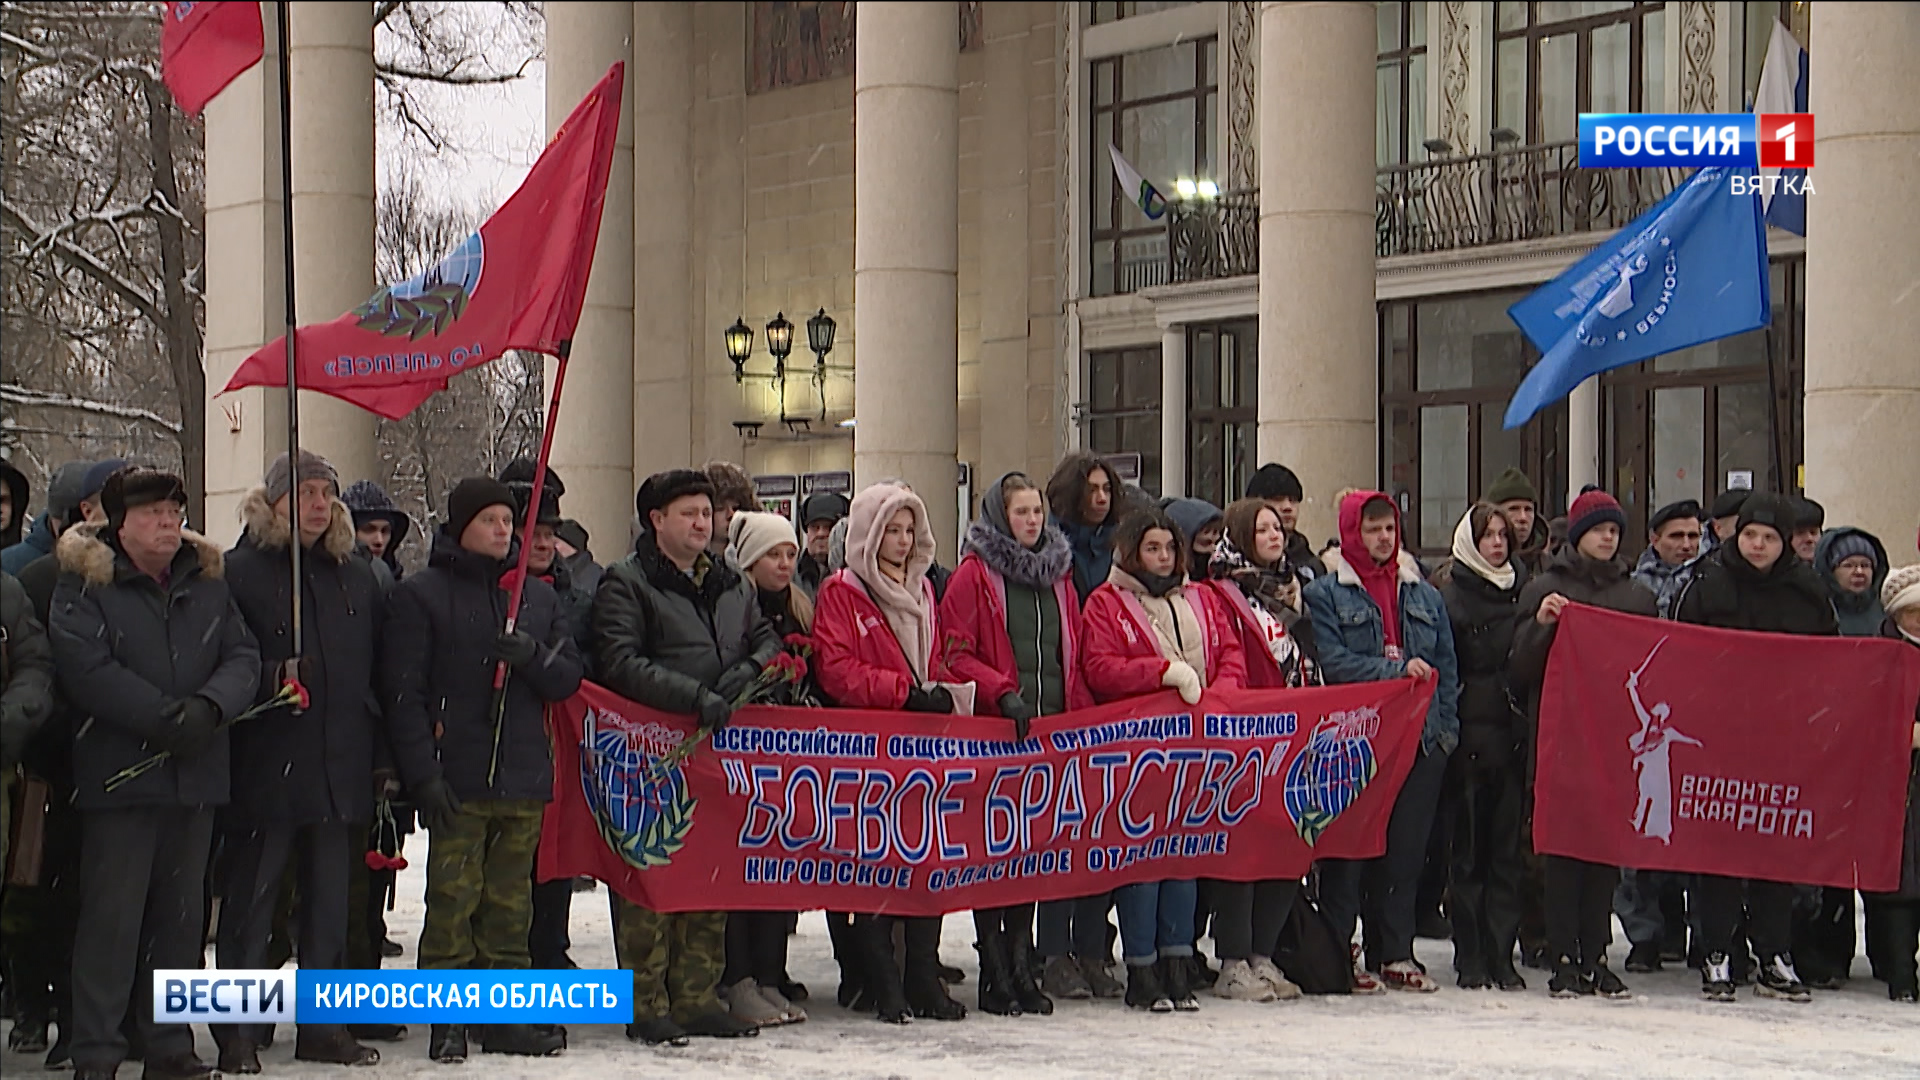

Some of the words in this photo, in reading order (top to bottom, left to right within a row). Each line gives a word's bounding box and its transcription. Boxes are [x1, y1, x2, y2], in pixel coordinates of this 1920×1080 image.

[712, 725, 880, 759] ВСЕРОССИЙСКАЯ
[887, 733, 1046, 764] ОБЩЕСТВЕННАЯ
[1051, 712, 1193, 753] ОРГАНИЗАЦИЯ
[1203, 712, 1299, 740] ВЕТЕРАНОВ
[1681, 774, 1800, 806] ВОЛОНТЕР
[744, 856, 913, 890] КИРОВСКОЕ
[928, 849, 1073, 893] ОБЛАСТНОЕ
[1087, 831, 1230, 871] ОТДЕЛЕНИЕ
